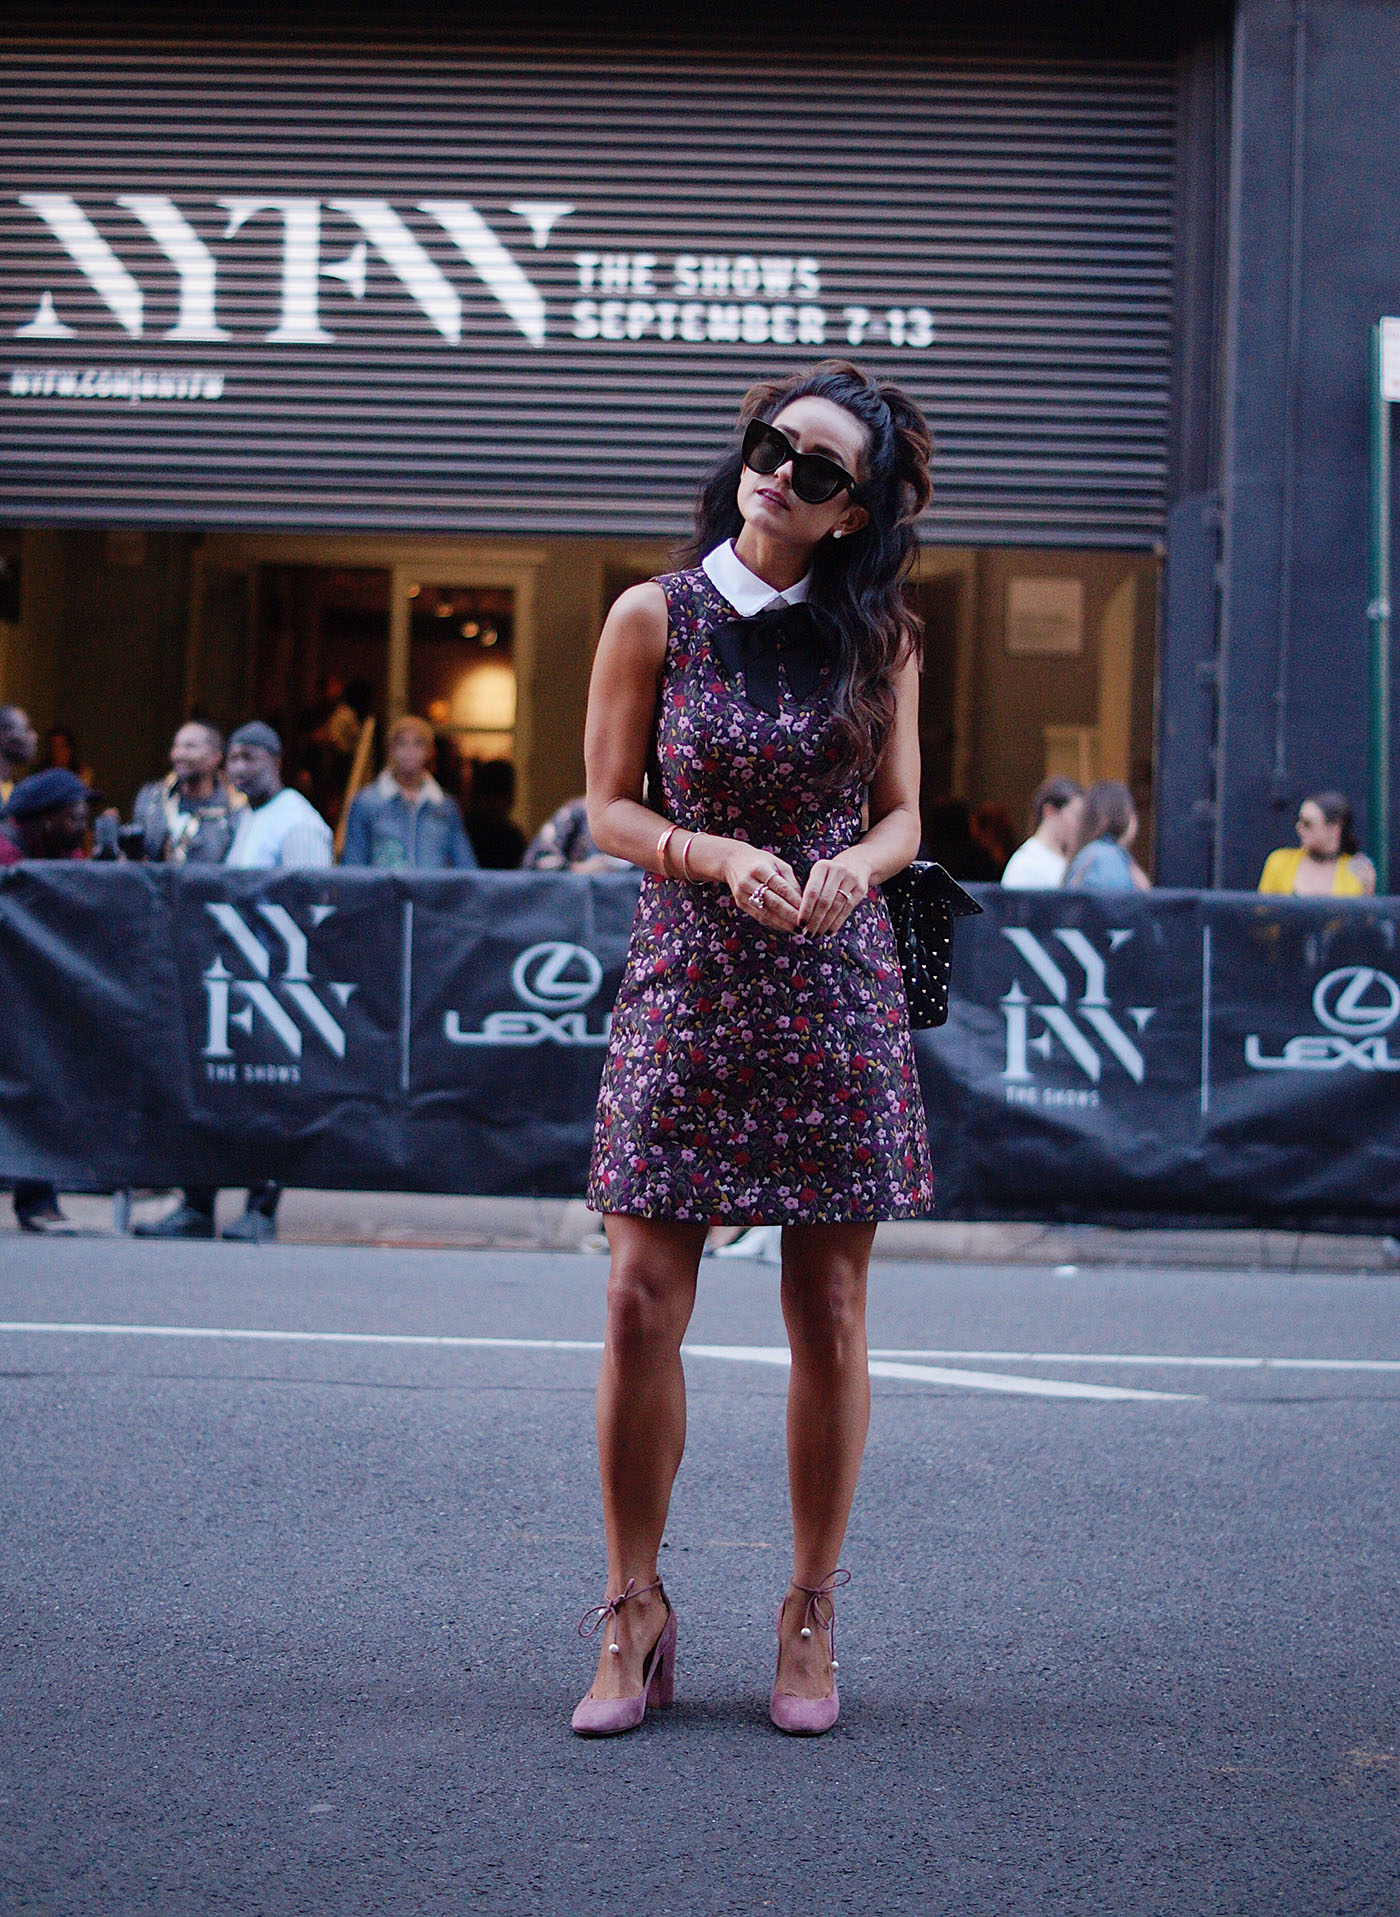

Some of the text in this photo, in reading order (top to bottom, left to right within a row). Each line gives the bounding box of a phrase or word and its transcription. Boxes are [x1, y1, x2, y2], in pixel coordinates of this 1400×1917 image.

[14, 194, 576, 348] NYFW
[574, 252, 821, 298] THE SHOWS
[572, 301, 934, 348] SEPTEMBER 7-13
[204, 902, 338, 980] NY
[1000, 926, 1135, 1006] NY
[203, 980, 360, 1061] FW
[444, 1009, 613, 1046] LEXU
[1000, 1006, 1157, 1085] FW
[1244, 1033, 1400, 1072] LEXU
[206, 1062, 302, 1084] THE SHOWS
[1005, 1085, 1036, 1105] THE
